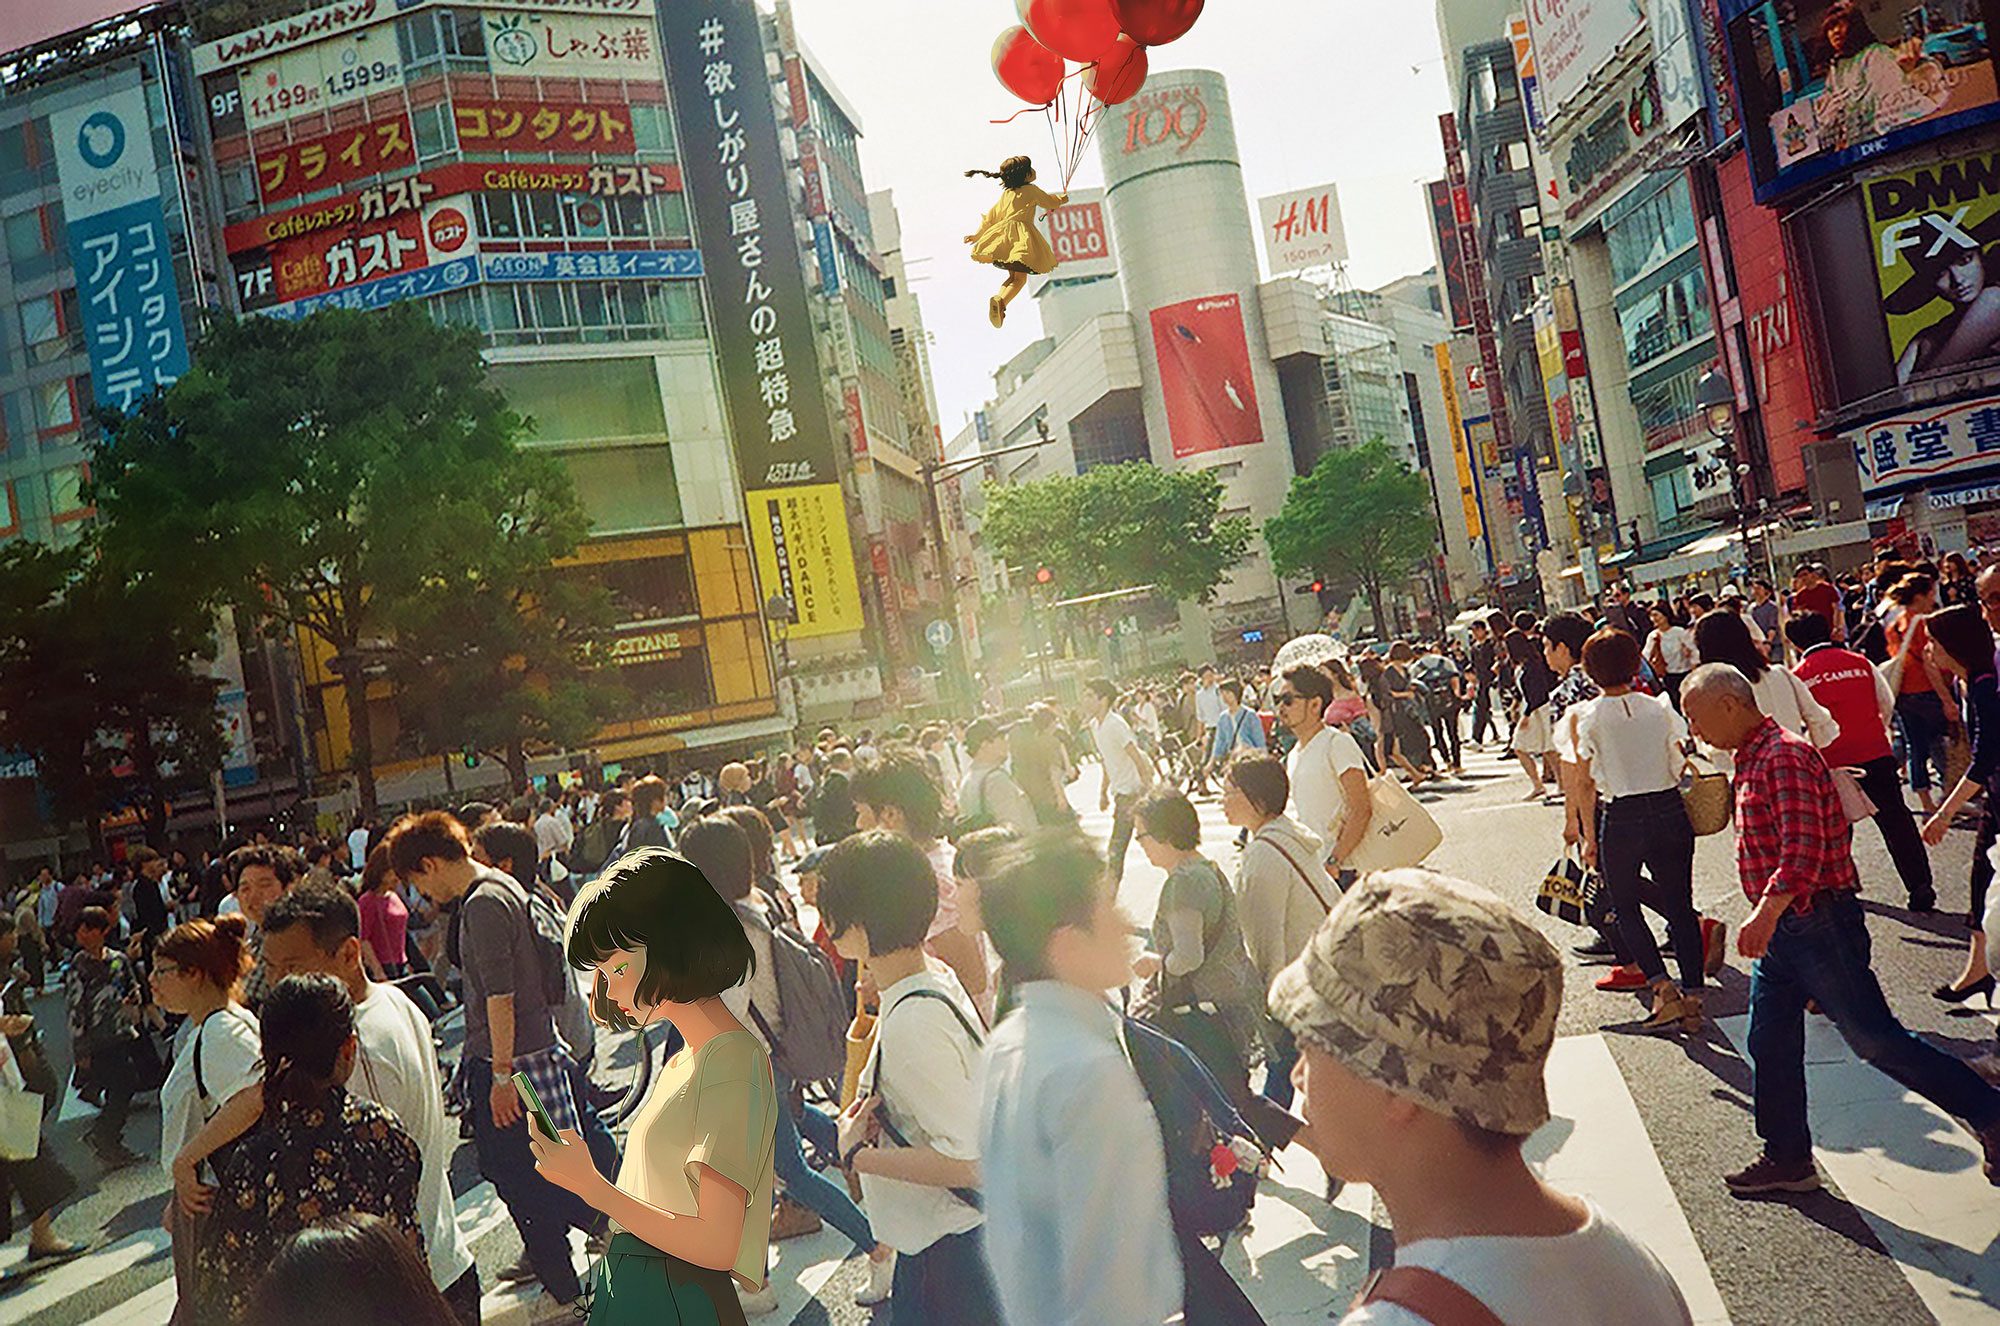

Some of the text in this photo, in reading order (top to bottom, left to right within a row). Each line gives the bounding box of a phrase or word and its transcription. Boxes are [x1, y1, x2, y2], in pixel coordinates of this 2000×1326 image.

[546, 26, 651, 61] しゃぶ葉
[211, 89, 239, 117] 9F
[455, 106, 626, 142] コンタクト
[1120, 98, 1209, 155] 109
[259, 122, 410, 193] プライス
[1861, 138, 1889, 156] DHC
[73, 165, 145, 201] eyecity
[587, 164, 665, 196] ガスト
[1869, 153, 2000, 222] DMM
[359, 177, 434, 222] ガスト
[433, 223, 465, 244] ガスト
[1053, 204, 1095, 232] UNI
[1272, 194, 1330, 243] H&M
[1057, 230, 1103, 256] QLO
[1881, 206, 1981, 268] FX
[281, 254, 321, 277] Café
[325, 229, 418, 288] ガスト
[492, 257, 544, 277] AEON
[553, 254, 697, 276] 英会話イーオン
[1283, 246, 1320, 264] 150m
[239, 265, 273, 299] 7F
[1931, 492, 1961, 508] ONE
[771, 515, 785, 546] NOW
[776, 547, 788, 567] ON
[1823, 668, 1870, 683] CAMERA
